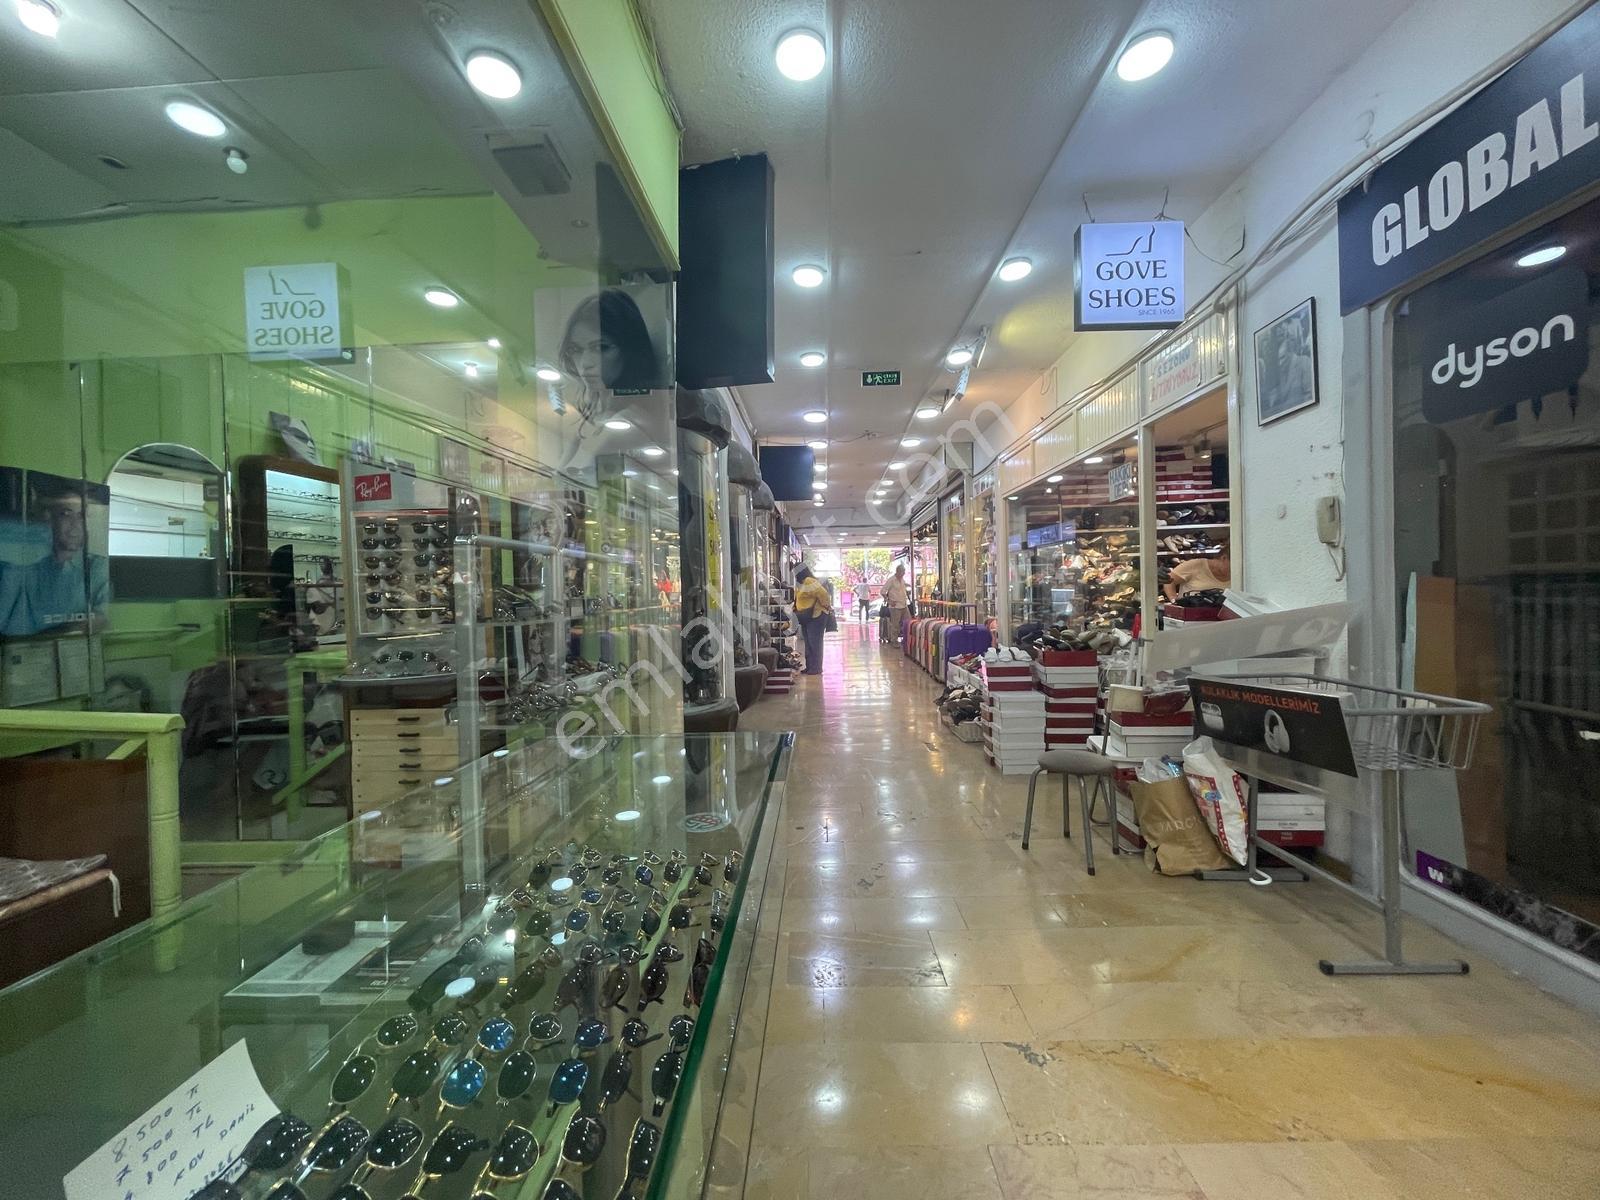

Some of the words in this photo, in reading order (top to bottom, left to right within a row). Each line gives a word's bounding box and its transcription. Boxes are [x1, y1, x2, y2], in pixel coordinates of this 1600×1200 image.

[1371, 73, 1599, 266] GLOBAL
[1095, 260, 1168, 281] GOVE
[1088, 287, 1176, 309] SHOES
[1431, 313, 1575, 389] dyson
[356, 475, 389, 498] Ray-Ban
[192, 1113, 214, 1139] TL
